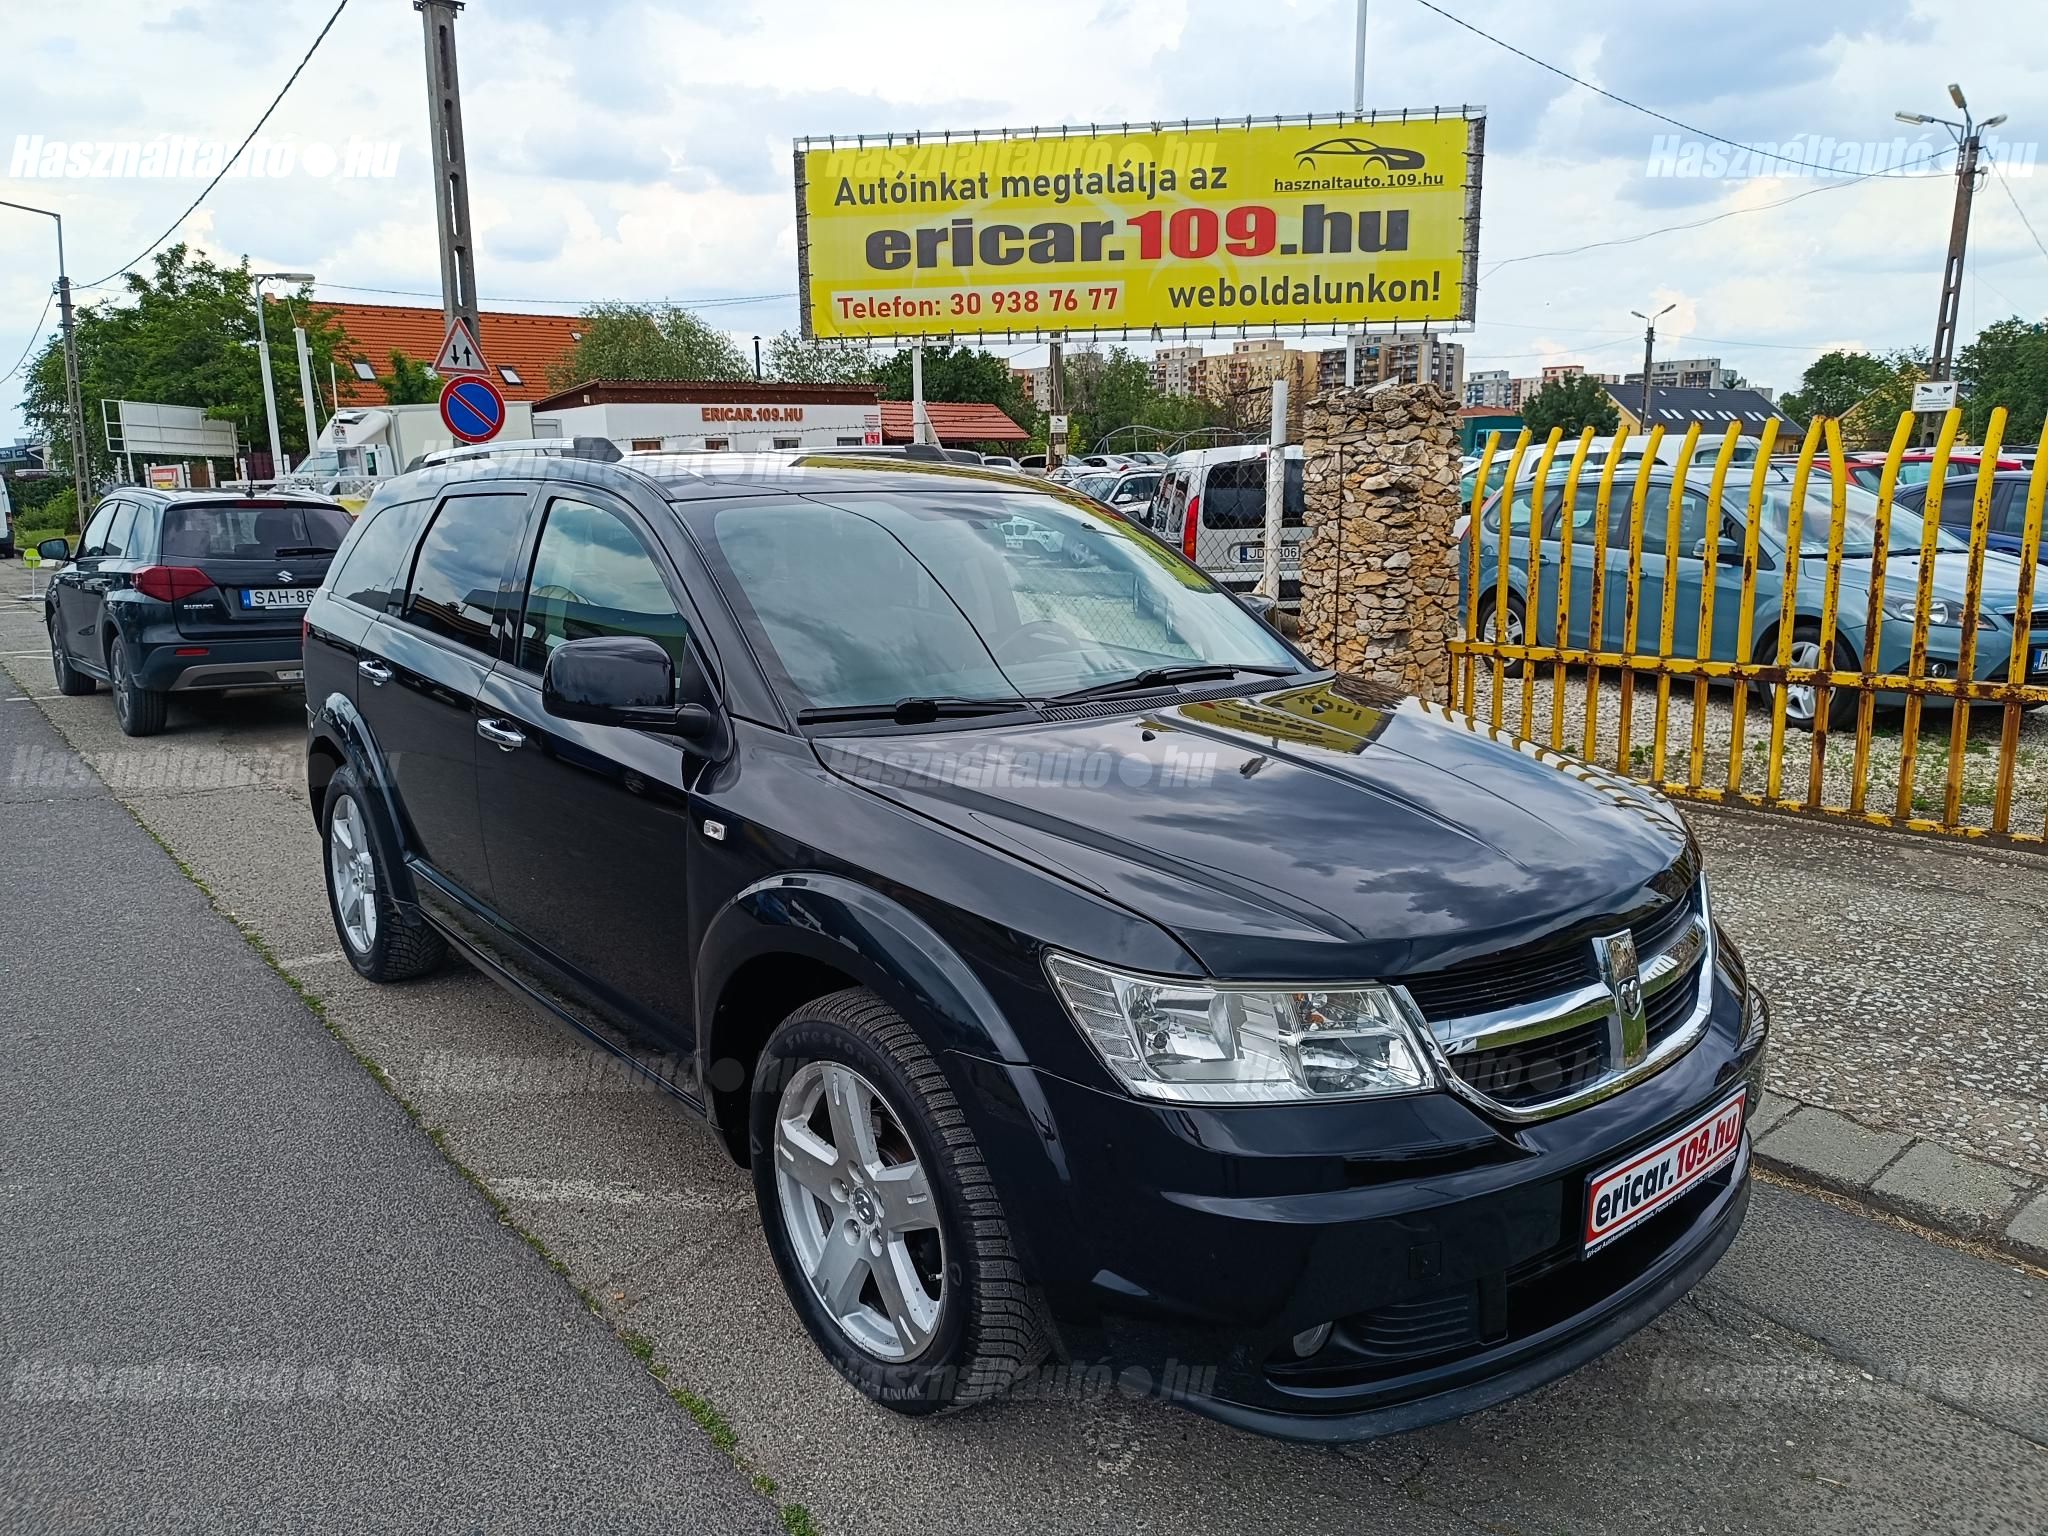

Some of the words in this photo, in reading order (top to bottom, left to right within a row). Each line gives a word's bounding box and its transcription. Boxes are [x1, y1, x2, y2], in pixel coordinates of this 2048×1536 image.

[834, 172, 989, 206] Autóinkat
[1001, 159, 1176, 204] megtalálja
[1190, 166, 1228, 190] az
[1274, 173, 1444, 191] hasznaltauto.109.hu
[866, 204, 1409, 270] ericar.109.hu
[837, 295, 940, 319] Telefon:
[950, 292, 981, 315] 30
[991, 290, 1039, 314] 938
[1049, 289, 1078, 312] 76
[1088, 287, 1118, 310] 77
[1168, 271, 1440, 308] weboldalunkon!
[702, 407, 803, 421] ERICAR.109.HU
[254, 591, 314, 604] SAH-86
[1595, 1113, 1737, 1228] ericar.109.hu
